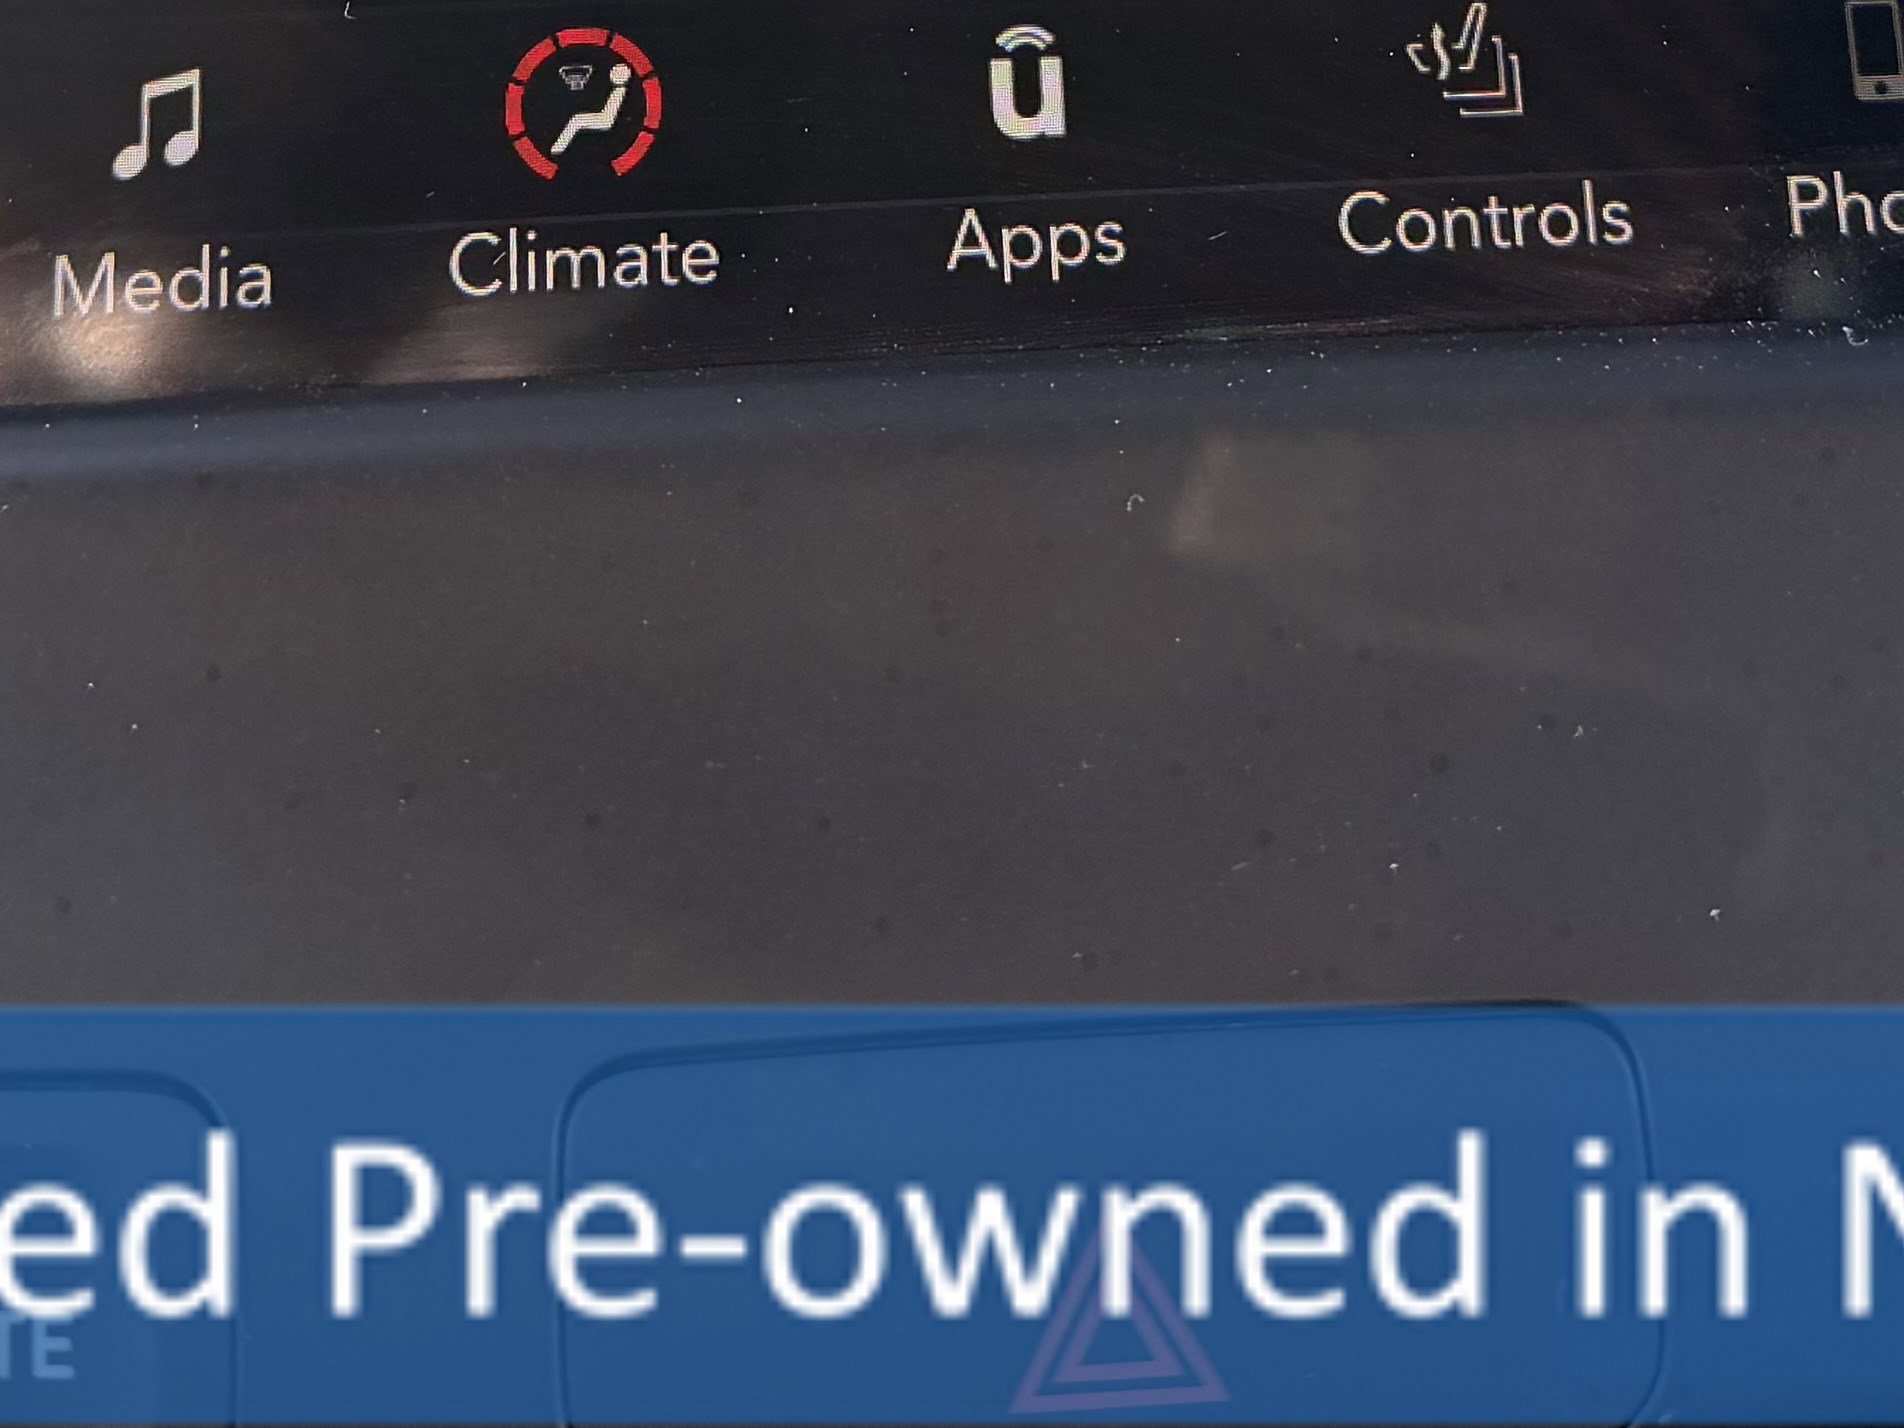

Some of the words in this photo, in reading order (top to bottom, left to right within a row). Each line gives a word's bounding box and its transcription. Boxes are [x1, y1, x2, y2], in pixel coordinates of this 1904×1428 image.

[946, 208, 1126, 284] Apps
[1338, 179, 1634, 255] Controls
[51, 243, 273, 320] Media
[449, 227, 720, 297] Climate
